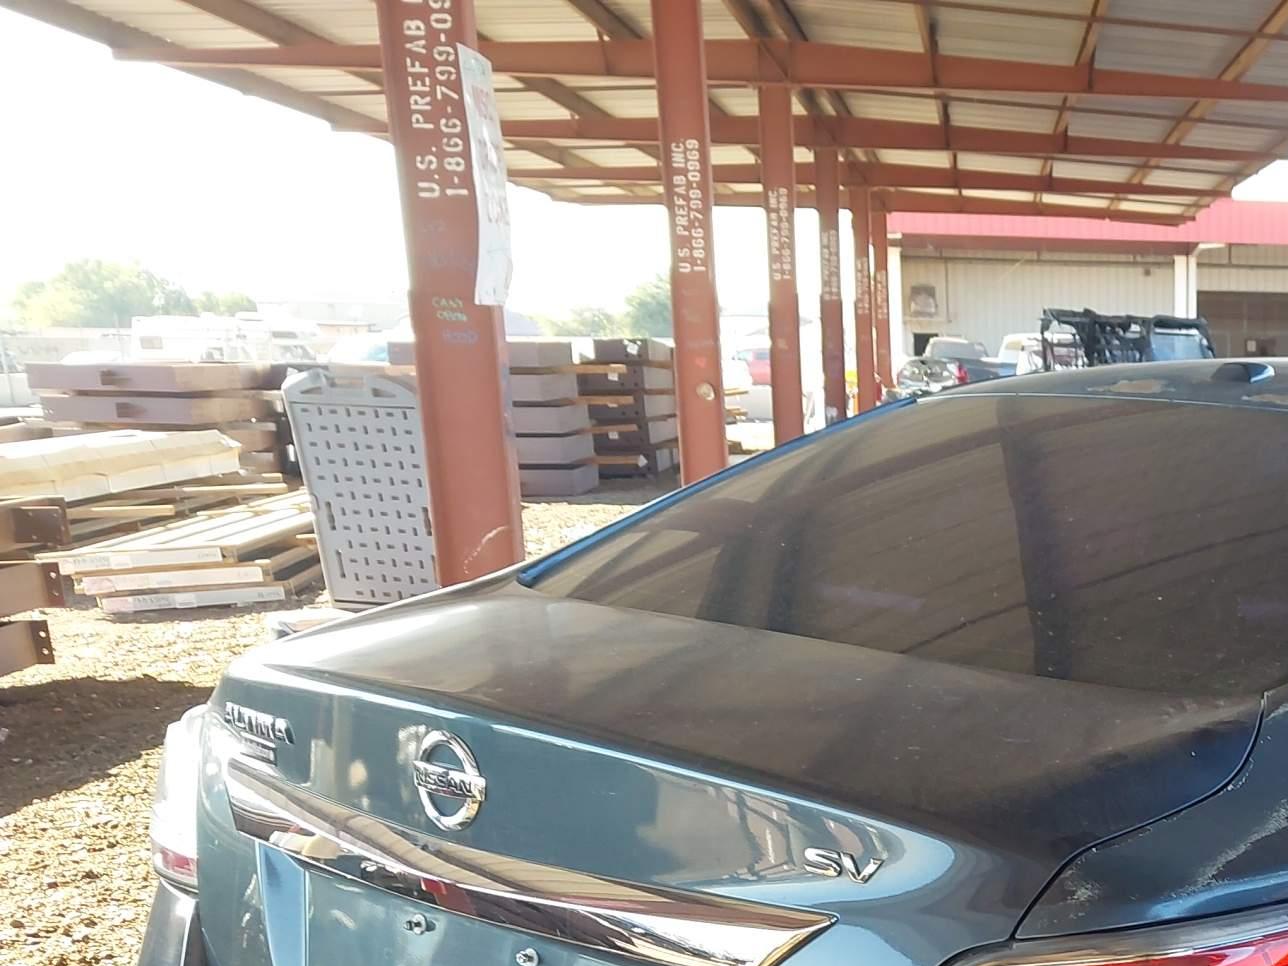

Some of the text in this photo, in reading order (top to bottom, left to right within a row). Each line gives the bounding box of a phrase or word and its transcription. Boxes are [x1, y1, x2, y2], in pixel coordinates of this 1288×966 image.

[403, 19, 434, 129] PREFAB
[416, 146, 440, 198] U.S.
[673, 174, 690, 236] PREFAB
[685, 138, 706, 271] 1-866-799-0969
[224, 701, 294, 745] ALTIMA
[415, 766, 479, 799] NISSAN
[804, 847, 885, 885] SV
